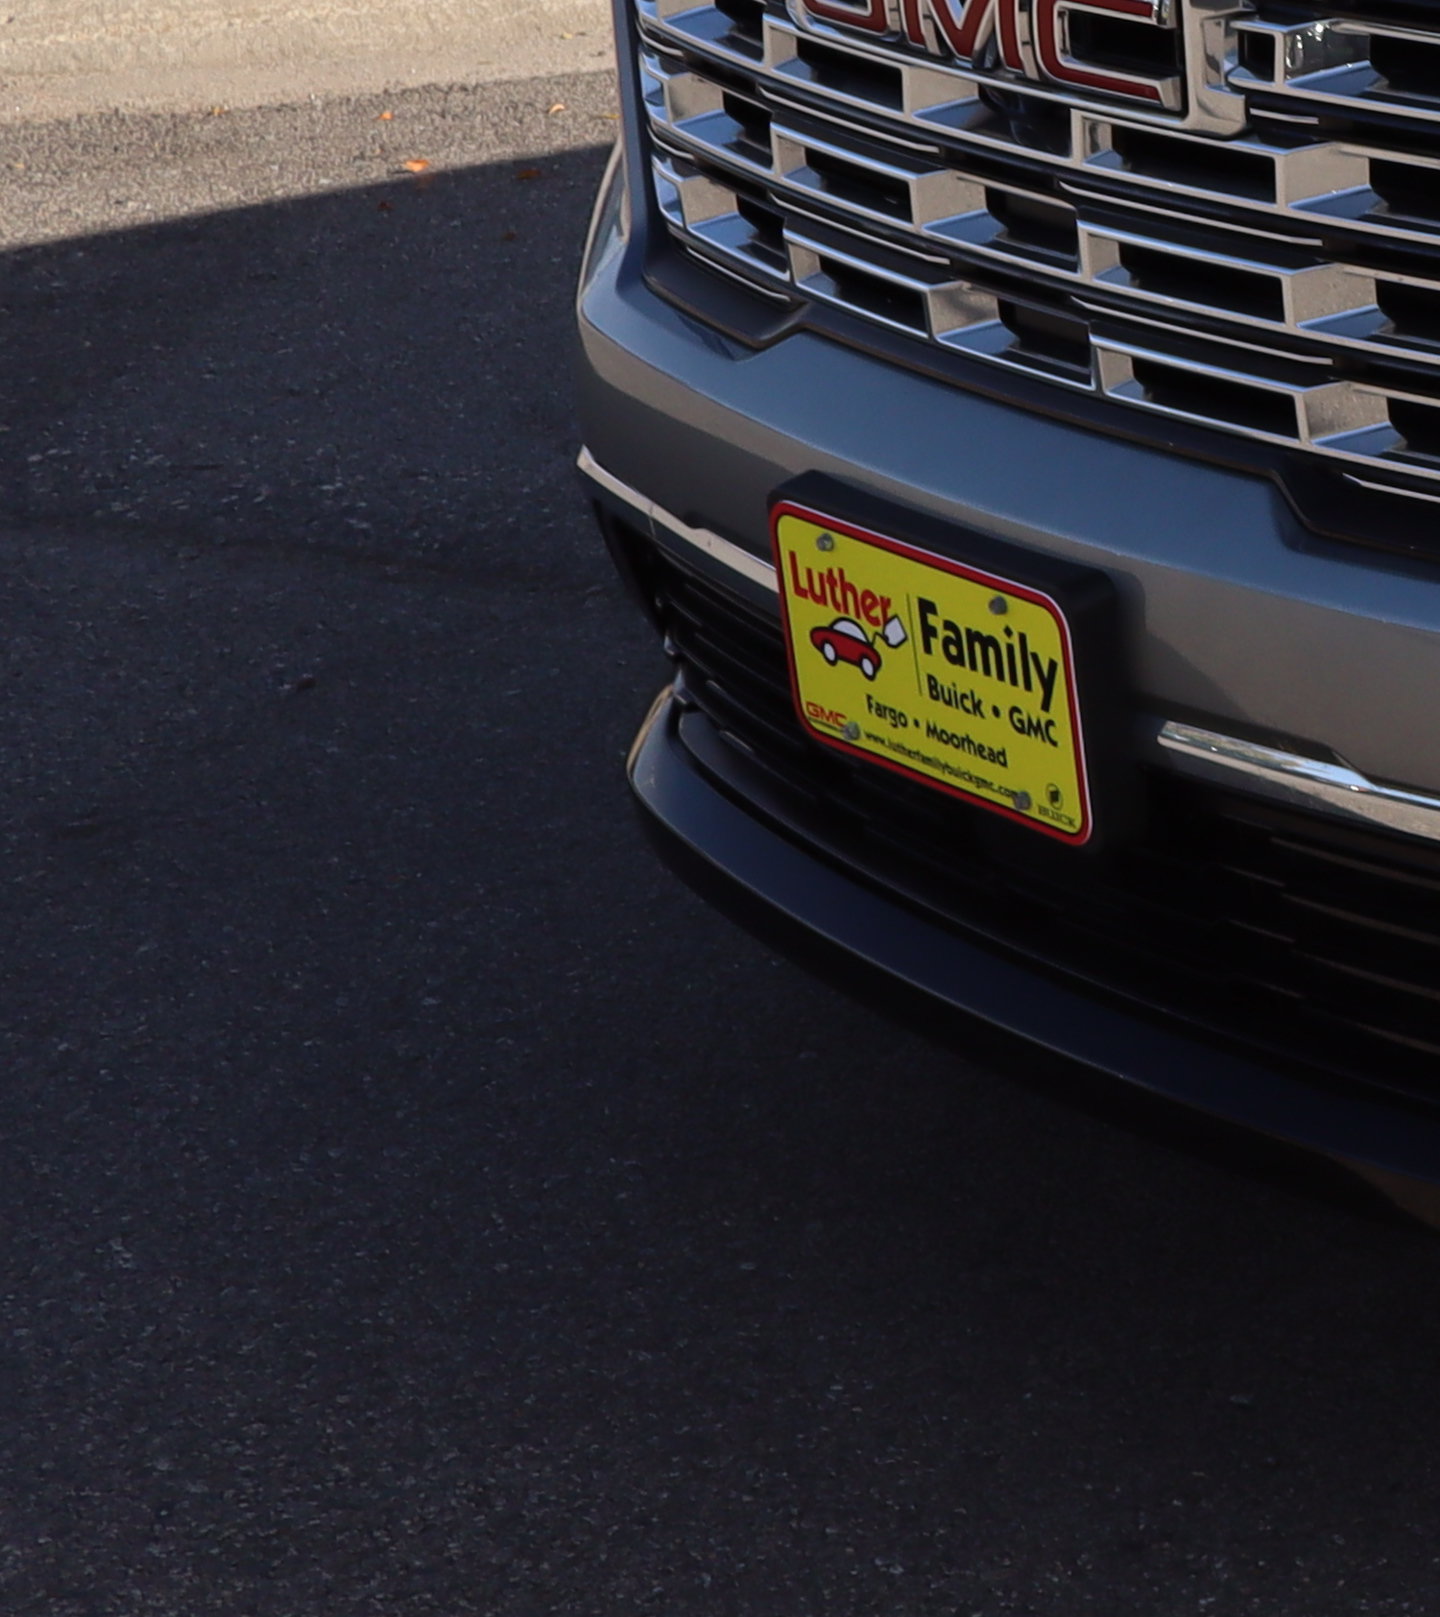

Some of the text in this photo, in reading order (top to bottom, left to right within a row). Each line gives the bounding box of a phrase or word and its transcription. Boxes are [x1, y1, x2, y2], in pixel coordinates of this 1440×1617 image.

[788, 550, 1059, 714] Luther Family
[805, 700, 848, 728] GMC
[865, 693, 1009, 768] Fargo Moorhead
[926, 673, 1059, 747] Buick GMC
[1037, 804, 1076, 829] BUICK
